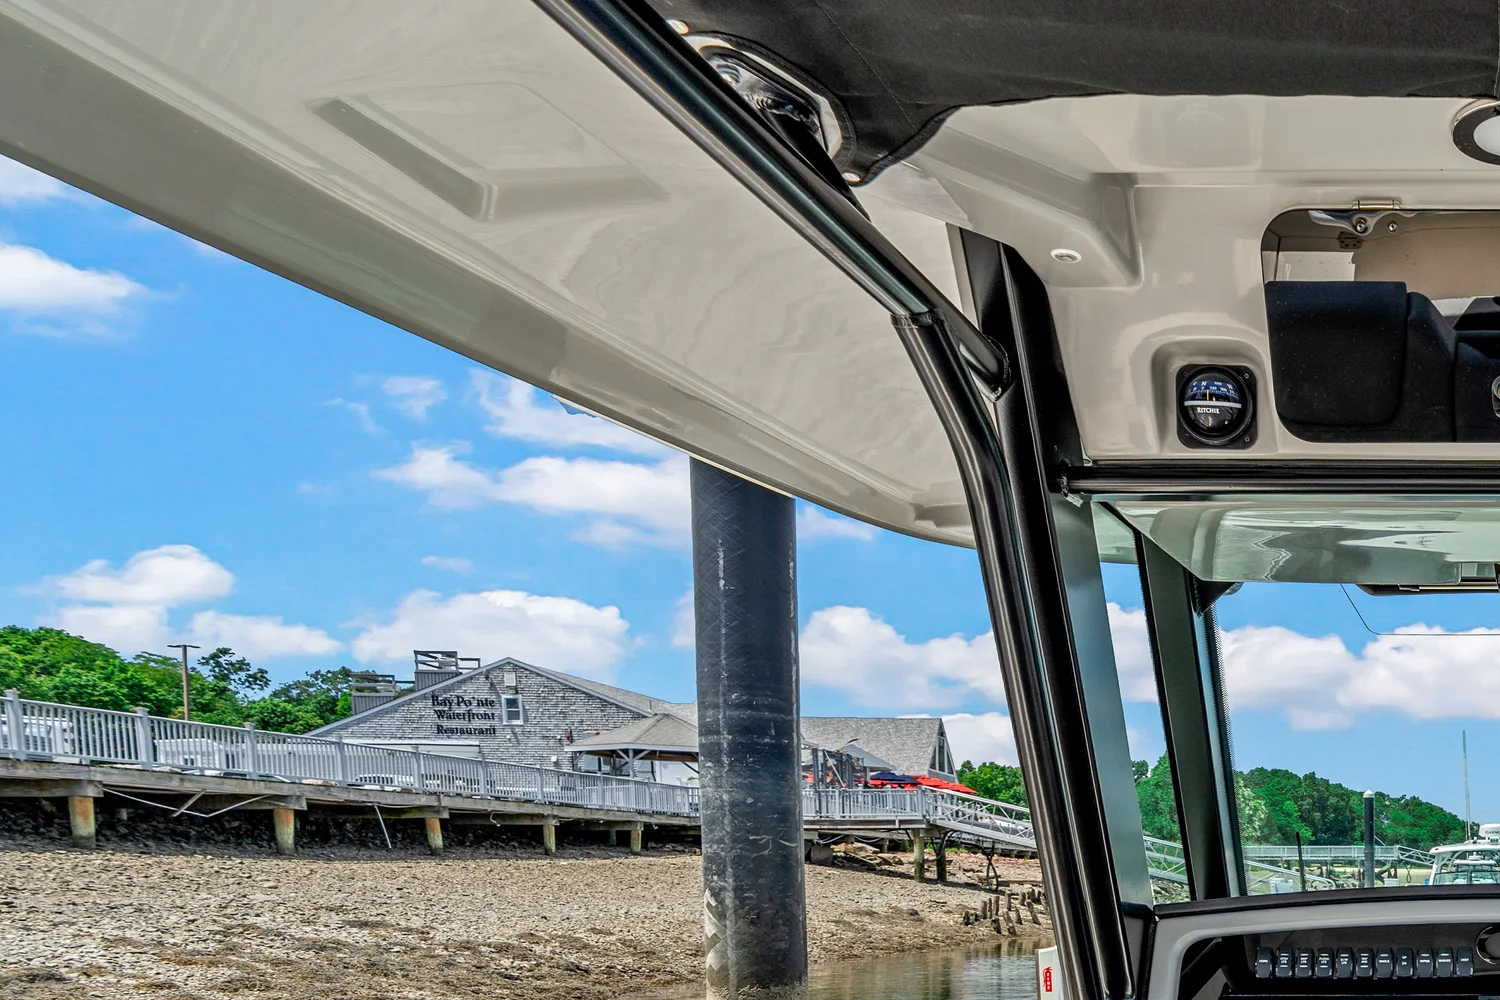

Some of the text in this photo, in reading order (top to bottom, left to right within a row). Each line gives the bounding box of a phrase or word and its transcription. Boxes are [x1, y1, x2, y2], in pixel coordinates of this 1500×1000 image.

[431, 695, 495, 709] Bay Ponte
[434, 709, 496, 722] Waterfront
[436, 725, 496, 735] Restaurant
